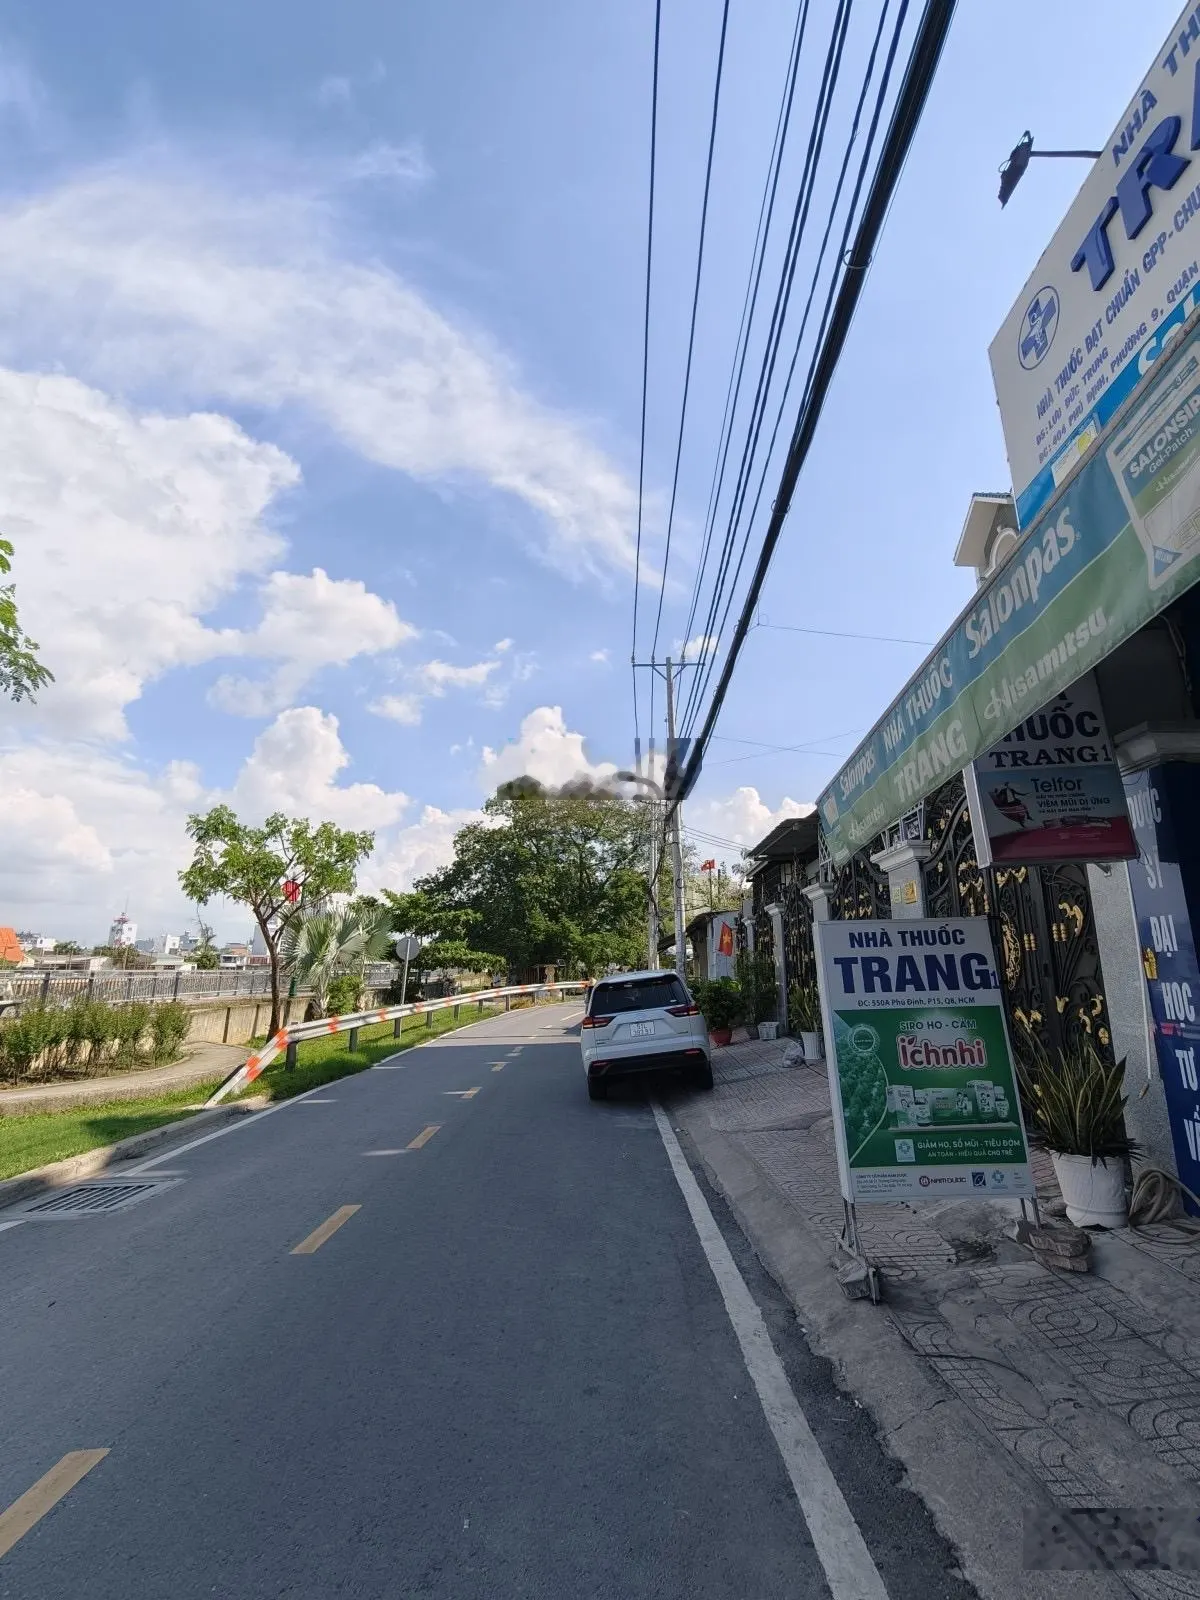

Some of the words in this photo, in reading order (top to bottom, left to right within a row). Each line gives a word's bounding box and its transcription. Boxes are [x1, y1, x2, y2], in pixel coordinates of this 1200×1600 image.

[1112, 89, 1158, 167] NHÀ
[1162, 3, 1200, 77] TH
[1070, 57, 1200, 291] TR
[1055, 345, 1083, 394] THUỐC
[1085, 319, 1104, 354] ĐẠT
[1105, 268, 1141, 325] CHUẨN
[1110, 322, 1148, 373] PHƯỜNG
[1082, 346, 1109, 385] TRUNG
[965, 507, 1075, 658] Salonpas
[984, 606, 1107, 720] Hisamitsu
[905, 656, 953, 726] THUỐC
[894, 719, 968, 802] TRANG
[1030, 777, 1083, 792] Telfor
[849, 928, 892, 948] NHÀ
[897, 923, 966, 947] THUỐC
[1150, 915, 1178, 957] ĐẠI
[900, 1021, 923, 1030] SIRO
[927, 1021, 942, 1030] HO
[951, 1018, 977, 1030] CẢM
[959, 996, 975, 1004] HCM
[1161, 982, 1195, 1027] HỌC
[1175, 1046, 1198, 1091] TƯ
